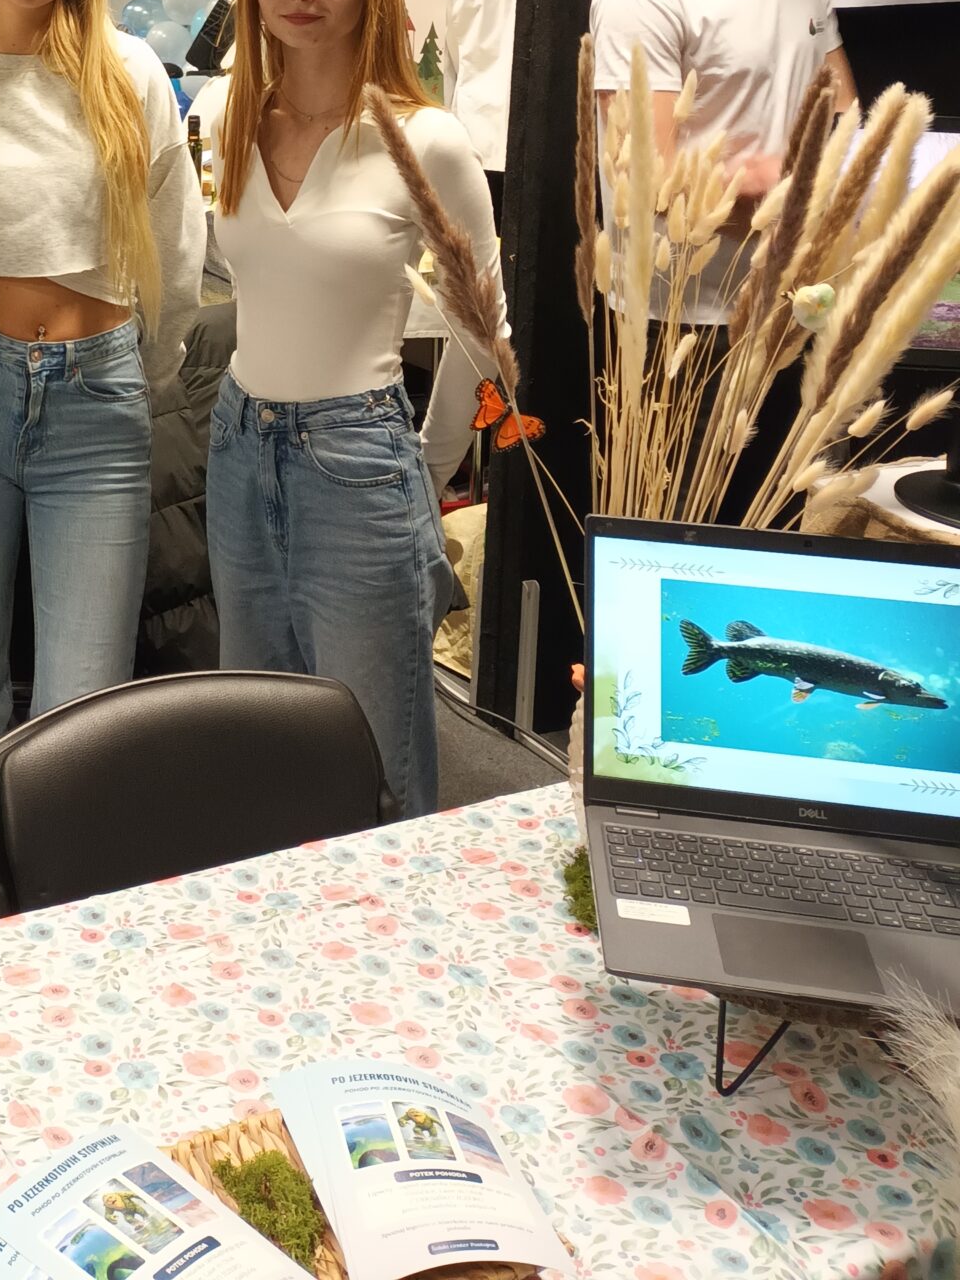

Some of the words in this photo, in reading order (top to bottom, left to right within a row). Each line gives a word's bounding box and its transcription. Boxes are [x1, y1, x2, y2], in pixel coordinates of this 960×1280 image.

[798, 807, 828, 820] DELL
[330, 1075, 346, 1085] PO
[348, 1073, 420, 1086] JEZERKOTOVIH
[7, 1199, 24, 1213] PO
[21, 1154, 81, 1202] JEZERKOTOVIH
[77, 1134, 122, 1158] STOPINJAH
[30, 1199, 53, 1217] POHOD
[51, 1192, 61, 1201] PO
